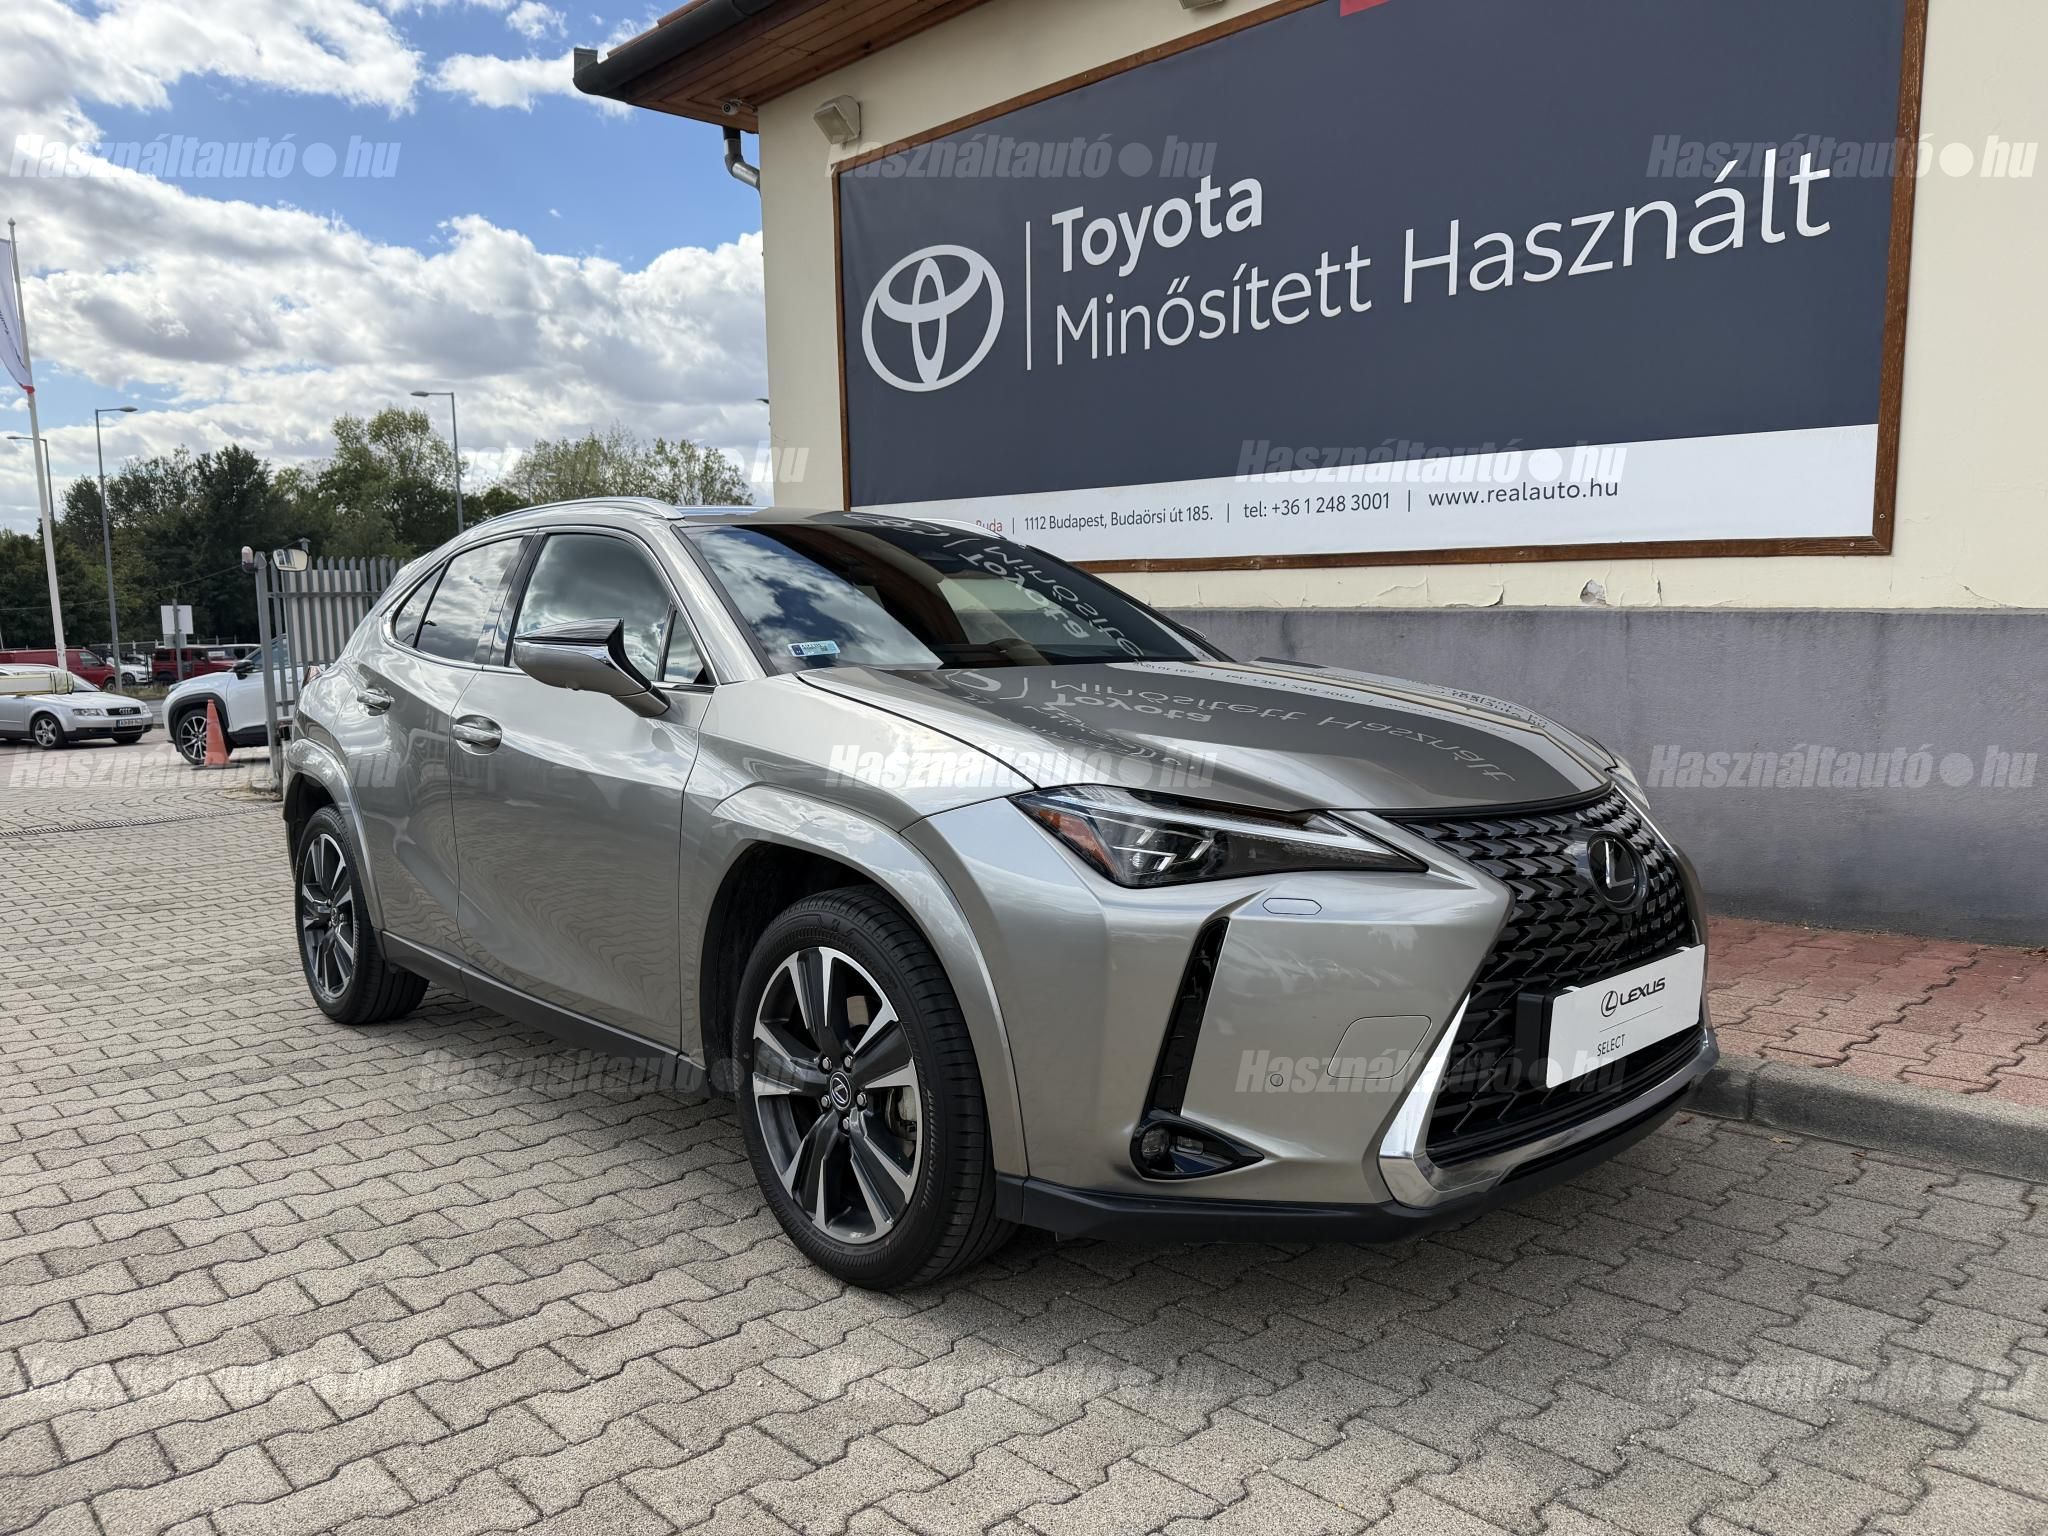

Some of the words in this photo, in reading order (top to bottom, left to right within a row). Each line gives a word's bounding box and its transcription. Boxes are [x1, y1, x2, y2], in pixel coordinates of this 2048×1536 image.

[1051, 175, 1263, 277] Toyota
[1057, 245, 1372, 366] Minősített
[1403, 148, 1831, 303] Használt
[1024, 516, 1046, 530] 1112
[1049, 513, 1107, 531] Budapest,
[1111, 508, 1166, 526] Budaörsi
[1169, 506, 1183, 522] út
[1186, 505, 1213, 521] 185.
[1244, 500, 1267, 518] tel:
[1271, 498, 1300, 516] +36
[1304, 497, 1311, 515] 1
[1316, 495, 1346, 513] 248
[1350, 492, 1390, 511] 3001
[1428, 478, 1619, 507] www.realauto.hu
[1620, 977, 1666, 1006] LEXUS
[1597, 1033, 1626, 1057] SELECT
